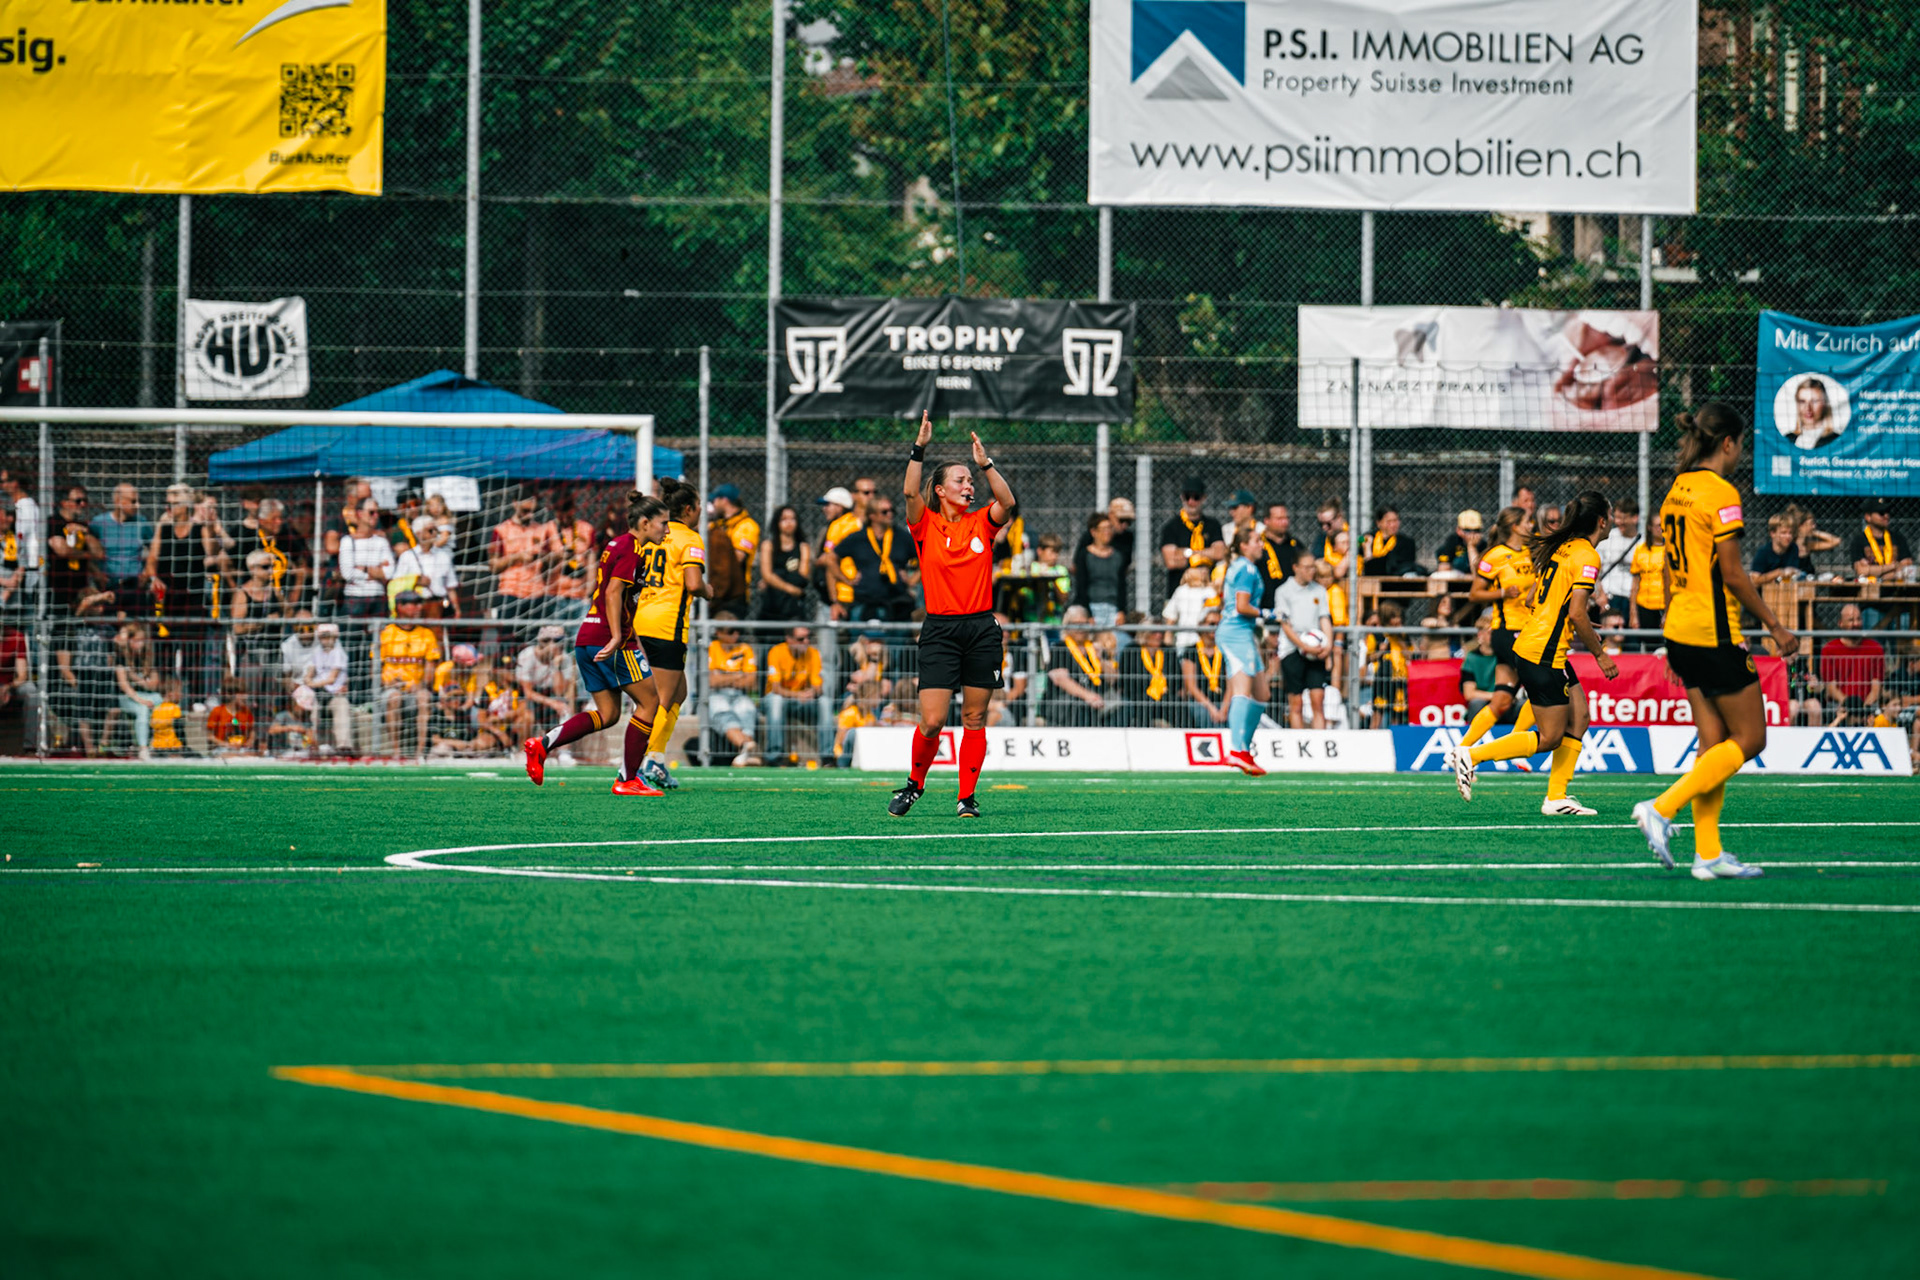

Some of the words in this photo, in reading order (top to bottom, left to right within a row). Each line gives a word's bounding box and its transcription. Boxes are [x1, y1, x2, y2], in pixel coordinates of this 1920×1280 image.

[0, 27, 67, 74] sig.
[1264, 29, 1338, 60] P.S.I.
[1353, 30, 1573, 64] IMMOBILIEN
[1588, 33, 1644, 65] AG
[1263, 68, 1361, 98] Property
[1370, 69, 1442, 93] Suisse
[1452, 72, 1574, 96] Investment
[1130, 136, 1642, 182] www.psiimmobilien.ch
[883, 325, 1025, 353] TROPHY
[1774, 327, 1809, 351] Mit
[1814, 331, 1883, 353] Zurich
[1664, 513, 1689, 574] 31
[986, 738, 1071, 758] EKB
[1801, 731, 1893, 771] AXA
